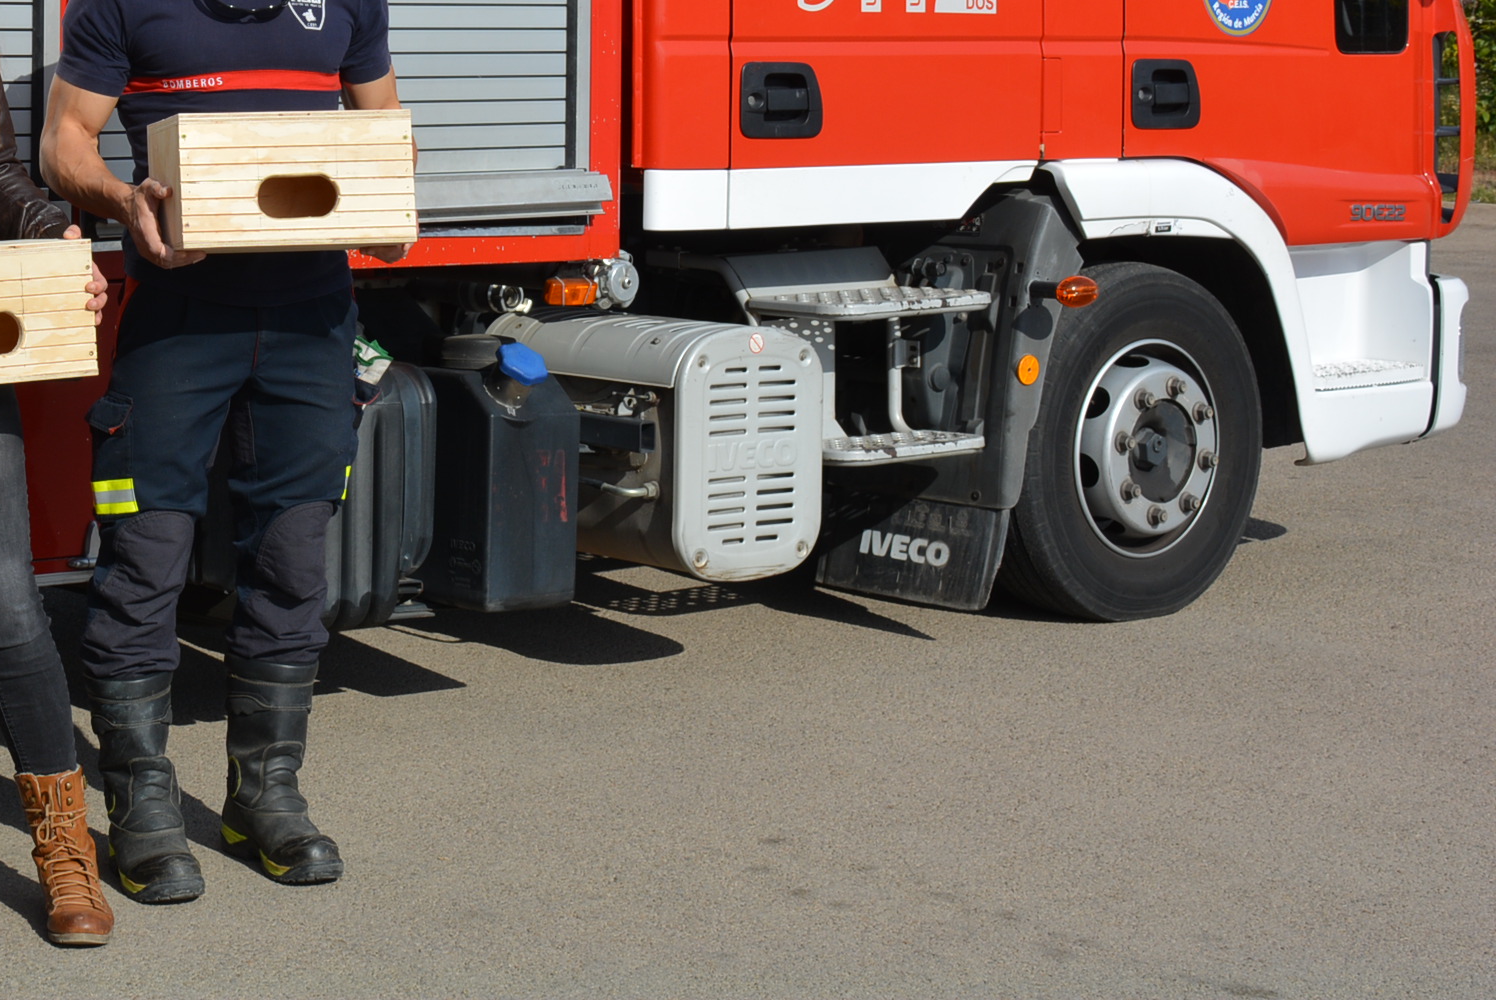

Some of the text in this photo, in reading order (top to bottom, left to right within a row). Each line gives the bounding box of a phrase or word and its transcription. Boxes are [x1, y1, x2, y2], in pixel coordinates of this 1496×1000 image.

[1233, 18, 1243, 28] de
[162, 76, 224, 89] BOMBEROS
[1349, 203, 1407, 221] 90E22
[707, 438, 798, 473] IVECO
[859, 529, 950, 567] IVECO
